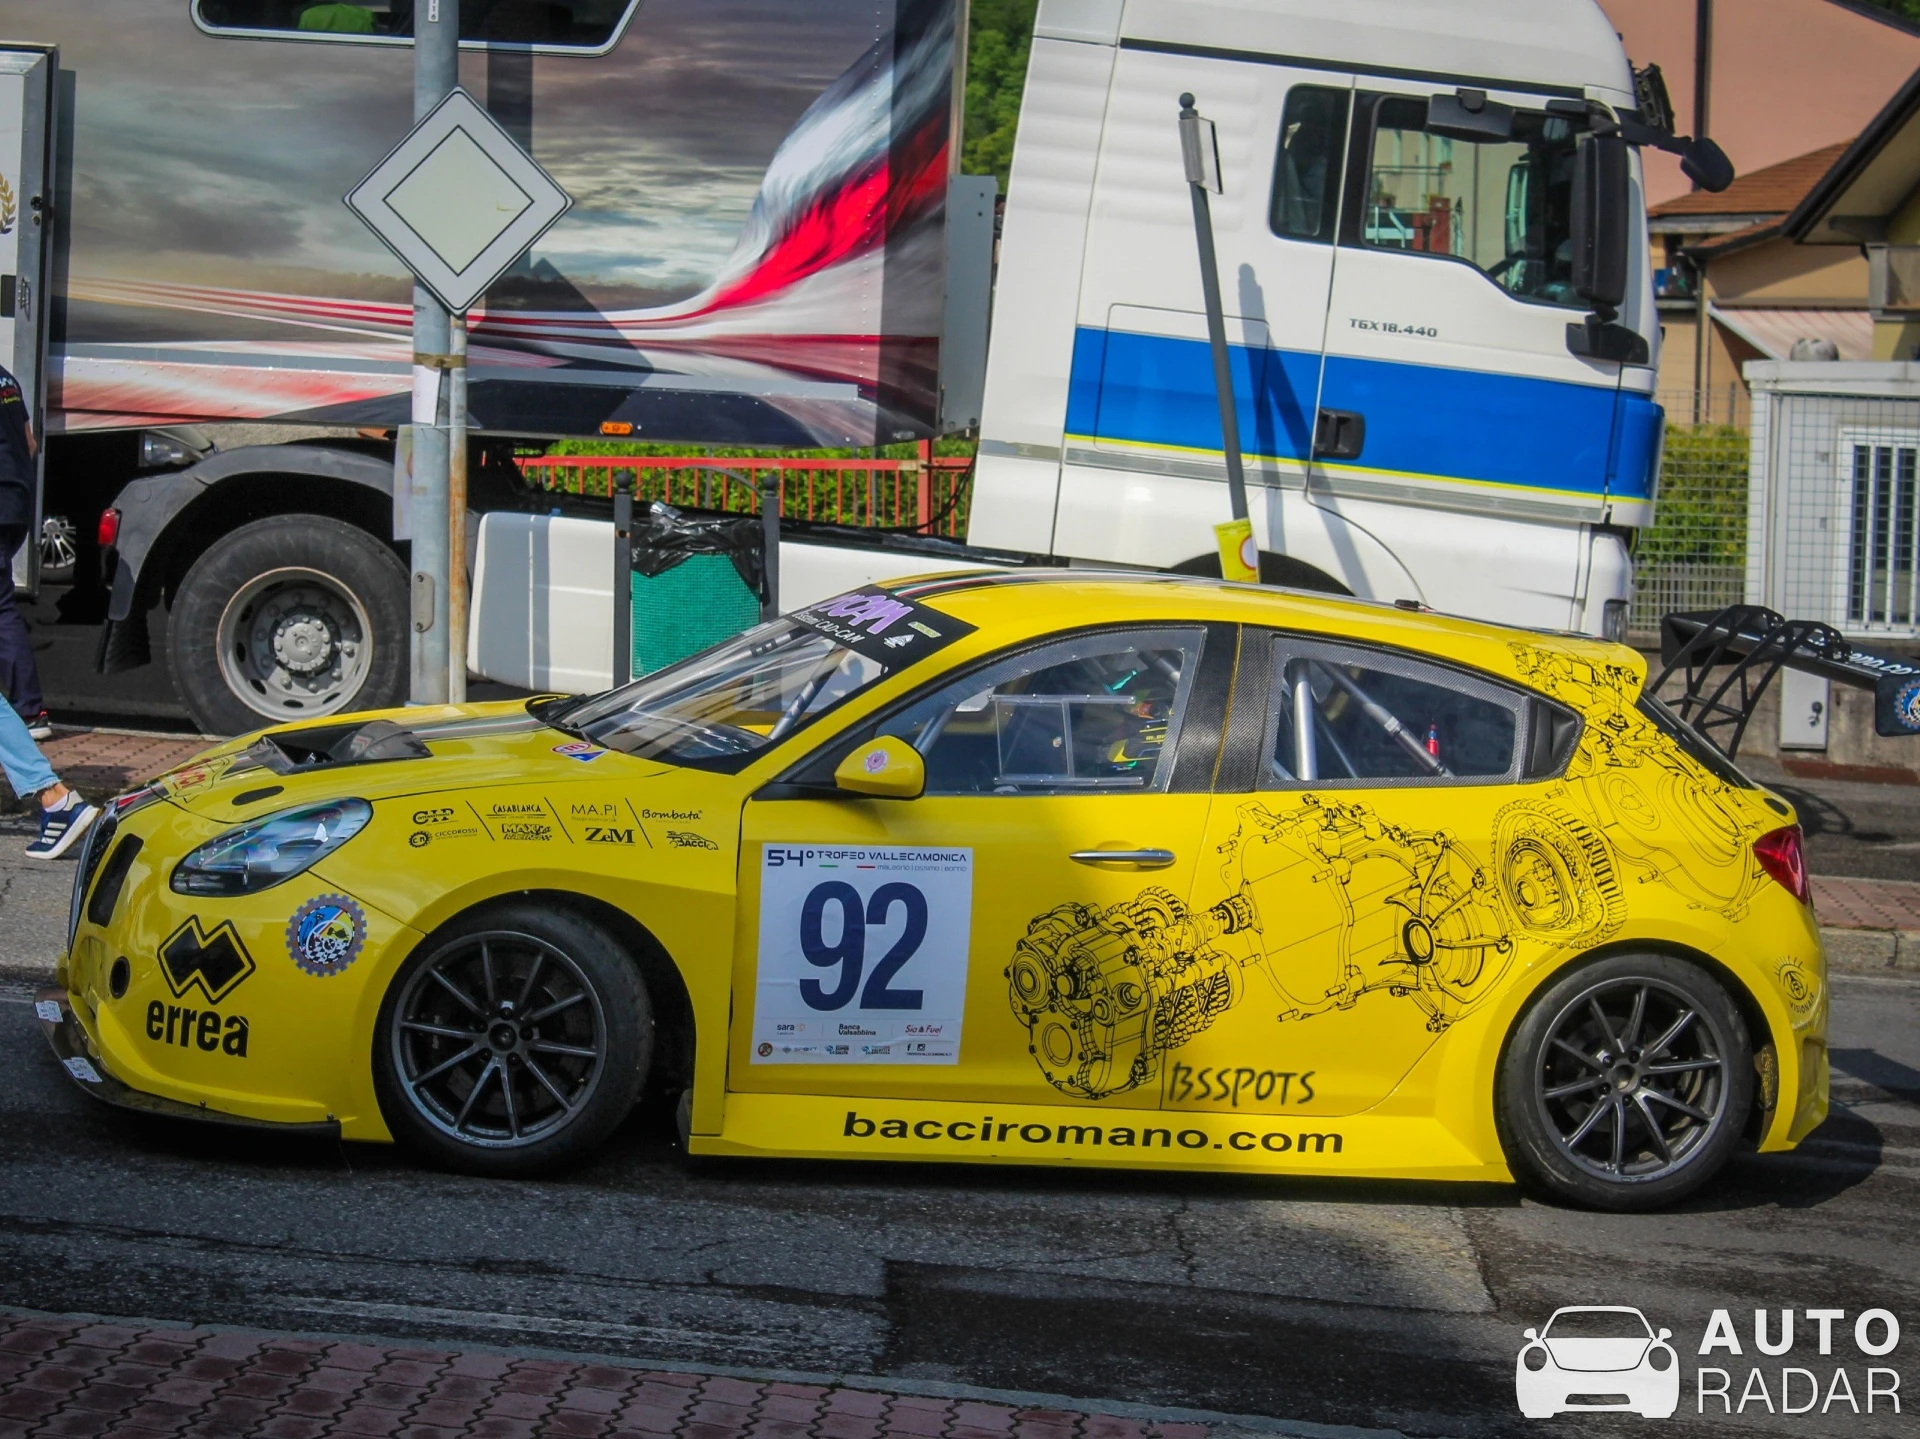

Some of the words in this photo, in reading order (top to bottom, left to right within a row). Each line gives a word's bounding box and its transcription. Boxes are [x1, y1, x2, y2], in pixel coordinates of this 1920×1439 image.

[1349, 318, 1379, 331] TGX
[1382, 322, 1437, 337] 18.440
[815, 621, 865, 643] CAD-CAM
[492, 803, 541, 816] CASABLANCA
[571, 804, 617, 816] MA.PI
[642, 809, 701, 820] Bombata
[434, 828, 478, 838] CICCOROSSI
[817, 850, 866, 860] TROFEO
[869, 852, 967, 862] VALLECAMONICA
[799, 880, 929, 1012] 92
[776, 1023, 795, 1031] sara
[843, 1111, 1344, 1154] bacciromano.com
